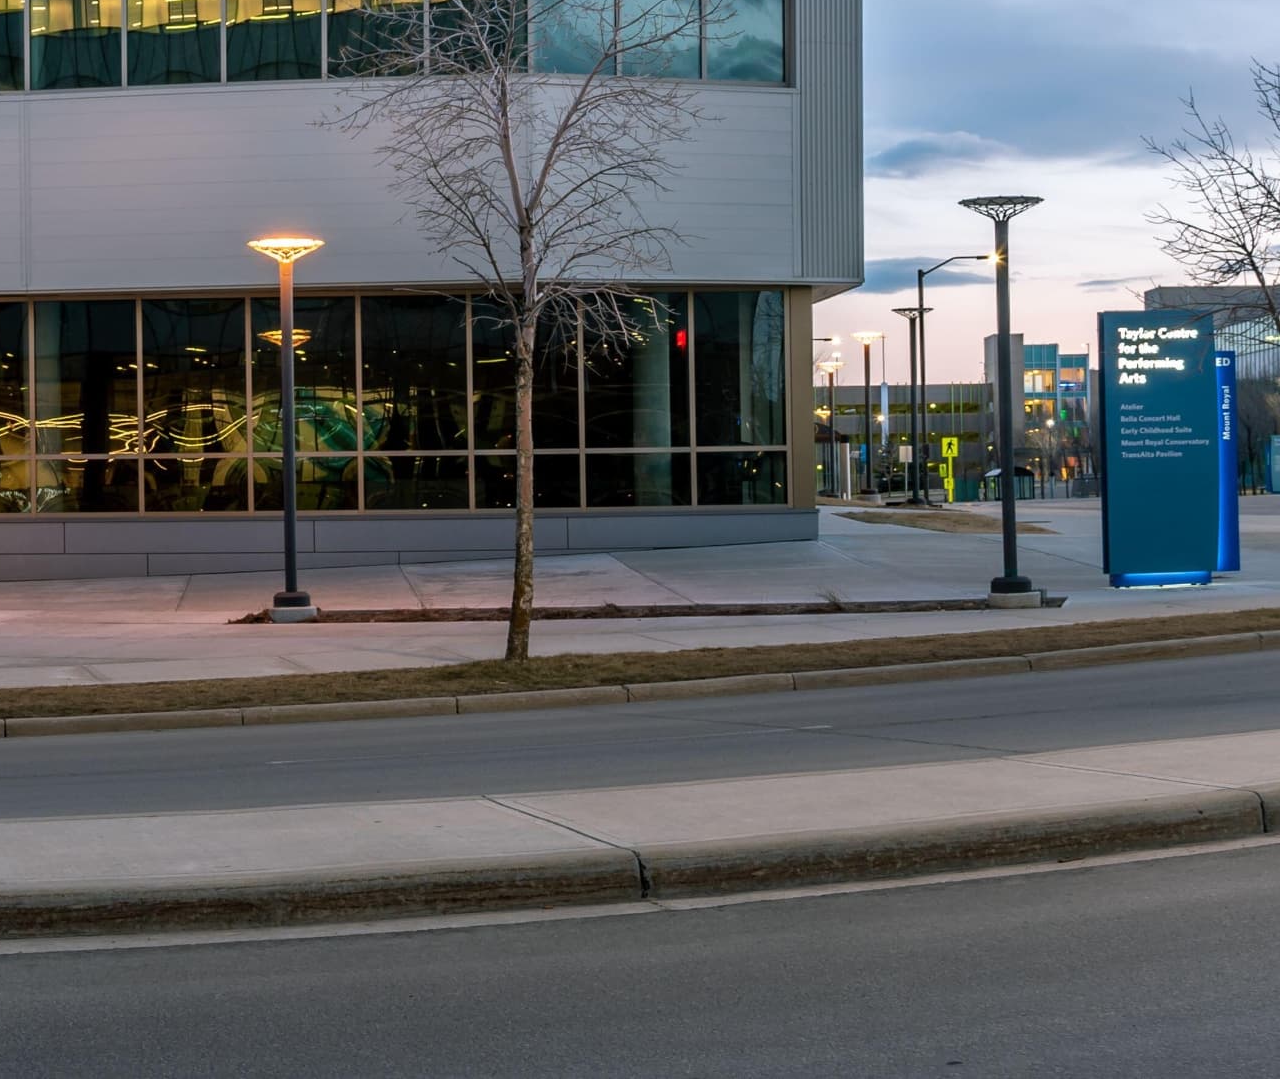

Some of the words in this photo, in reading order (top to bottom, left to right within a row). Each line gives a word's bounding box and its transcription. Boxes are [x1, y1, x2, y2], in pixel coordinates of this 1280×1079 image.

[1118, 327, 1156, 341] Taylor
[1158, 327, 1199, 339] Centre
[1118, 342, 1137, 354] for
[1138, 342, 1159, 354] the
[1118, 356, 1185, 370] Performing
[1119, 372, 1147, 384] Arts
[1222, 385, 1231, 409] Royal
[1120, 403, 1144, 411] Atelier
[1120, 415, 1138, 423] Bella
[1167, 414, 1181, 422] Hall
[1120, 427, 1138, 435] Early
[1139, 426, 1174, 434] Childhood
[1222, 411, 1231, 440] Mount
[1145, 439, 1164, 447] Royal
[1164, 438, 1210, 446] Conservatory
[1155, 450, 1183, 458] Pavilion
